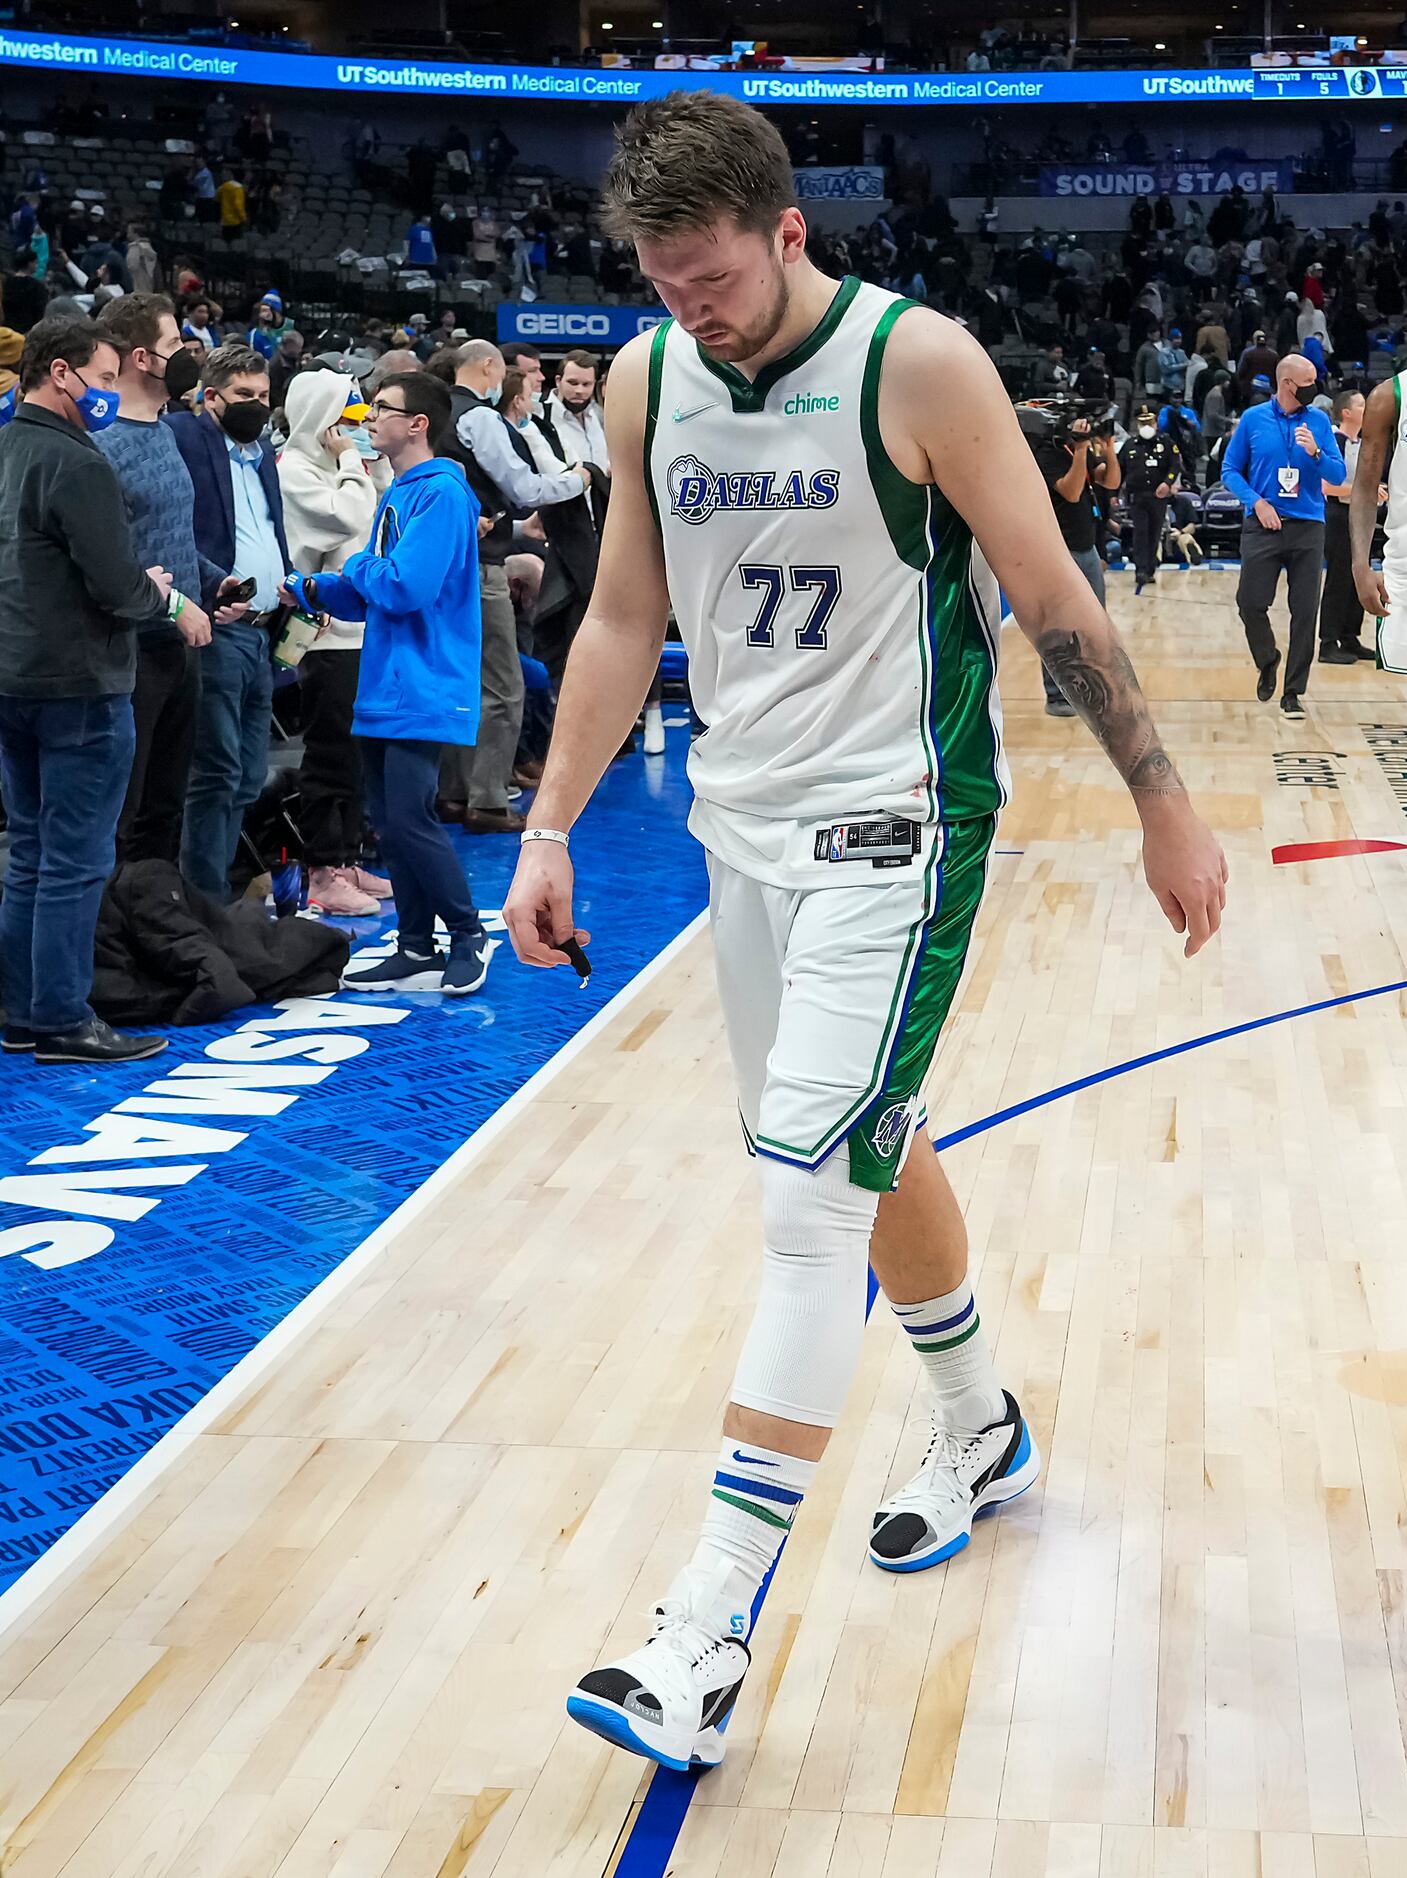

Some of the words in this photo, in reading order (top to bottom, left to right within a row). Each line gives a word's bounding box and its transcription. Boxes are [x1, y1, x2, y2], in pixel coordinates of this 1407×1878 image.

[104, 46, 175, 71] Medical
[178, 53, 238, 75] Center
[512, 73, 579, 94] Medical
[582, 76, 641, 95] Center
[1260, 73, 1300, 81] TIMEOUTS
[1311, 72, 1338, 81] FOULS
[1276, 83, 1283, 95] 1
[1319, 82, 1329, 95] 5
[913, 81, 982, 98] Medical
[984, 80, 1043, 97] Center
[1055, 174, 1155, 195] SOUND
[1177, 171, 1279, 193] STAGE
[516, 313, 610, 336] GEICO
[784, 393, 841, 416] chime
[671, 467, 842, 515] DALLAS
[739, 564, 842, 650] 77
[386, 1060, 492, 1083] MARK
[209, 1276, 288, 1300] TRACY
[121, 1290, 211, 1317] MOORE
[163, 1298, 259, 1328] SMITH
[78, 1381, 209, 1430] LUKA
